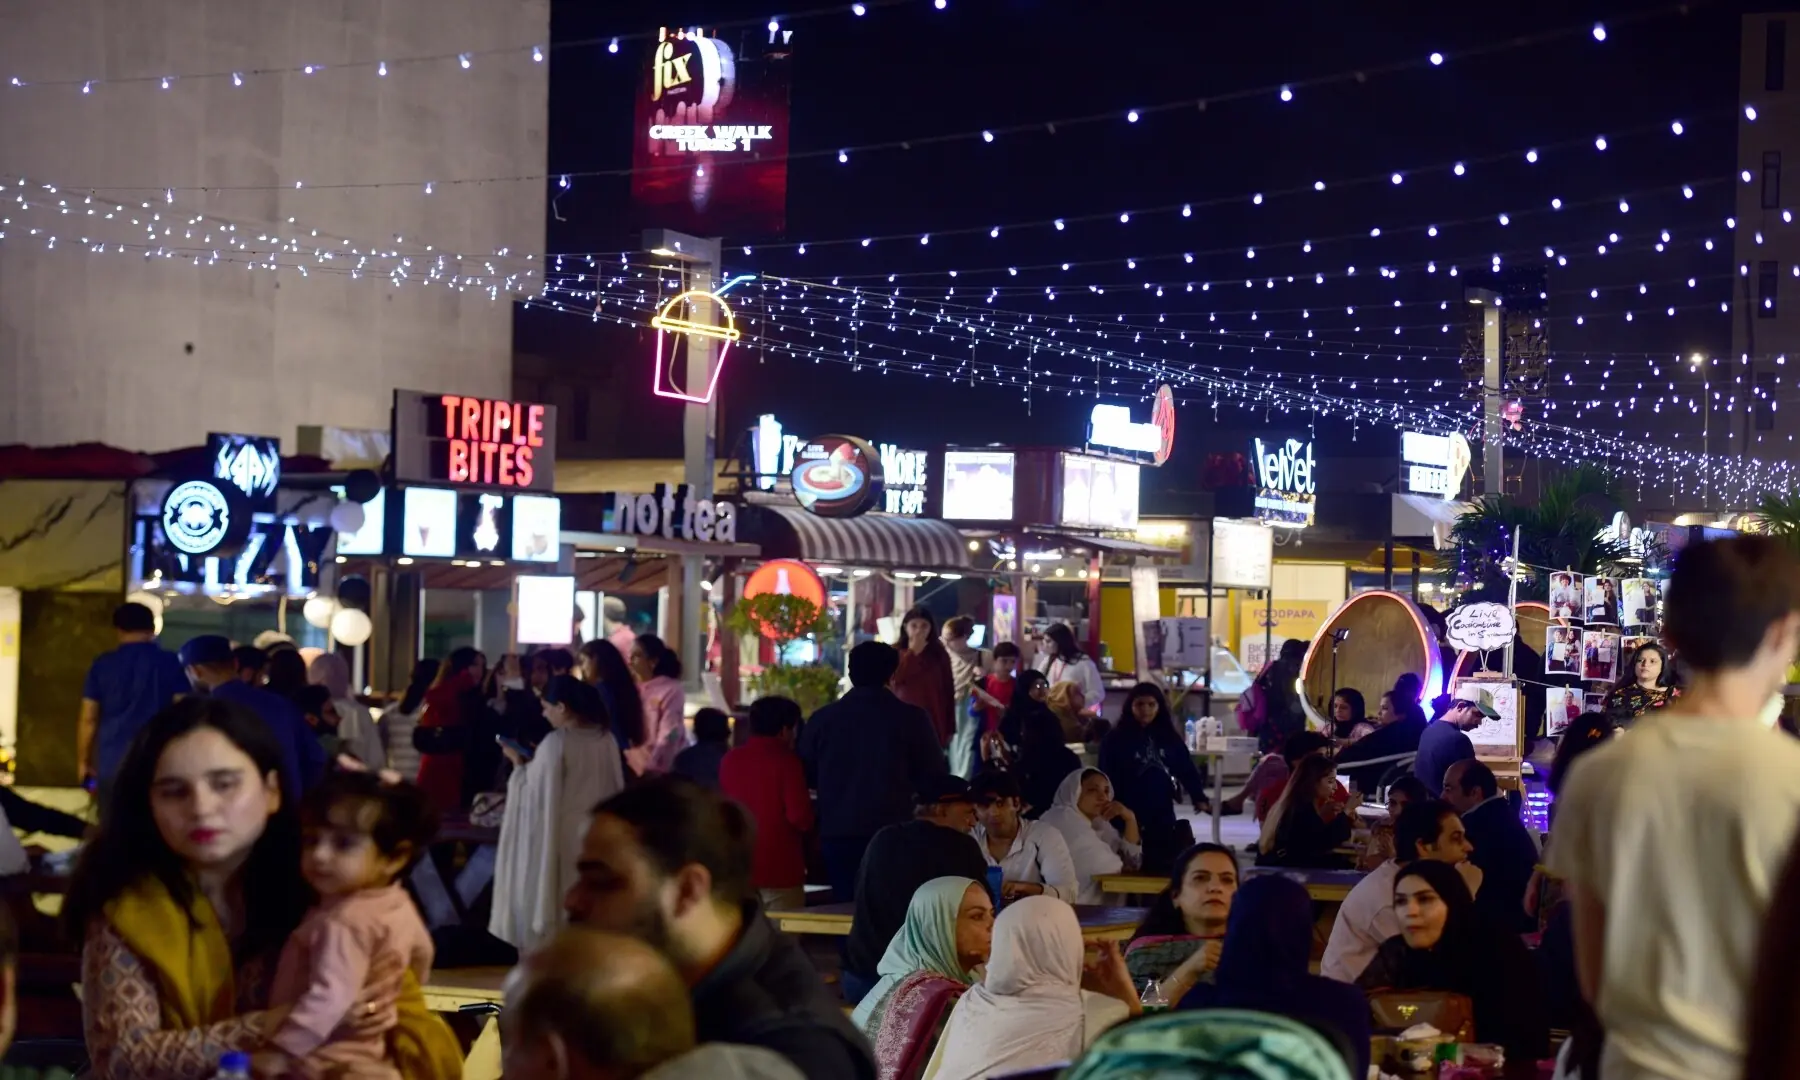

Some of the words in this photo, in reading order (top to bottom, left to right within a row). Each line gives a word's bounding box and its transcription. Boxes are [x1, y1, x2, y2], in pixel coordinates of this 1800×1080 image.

[652, 41, 693, 102] fix
[712, 125, 773, 139] WALK
[441, 393, 545, 447] TRIPLE
[448, 439, 534, 488] BITES
[879, 443, 927, 485] MORE
[1254, 437, 1316, 494] Velvet
[681, 482, 737, 543] tea
[1469, 609, 1498, 618] Live
